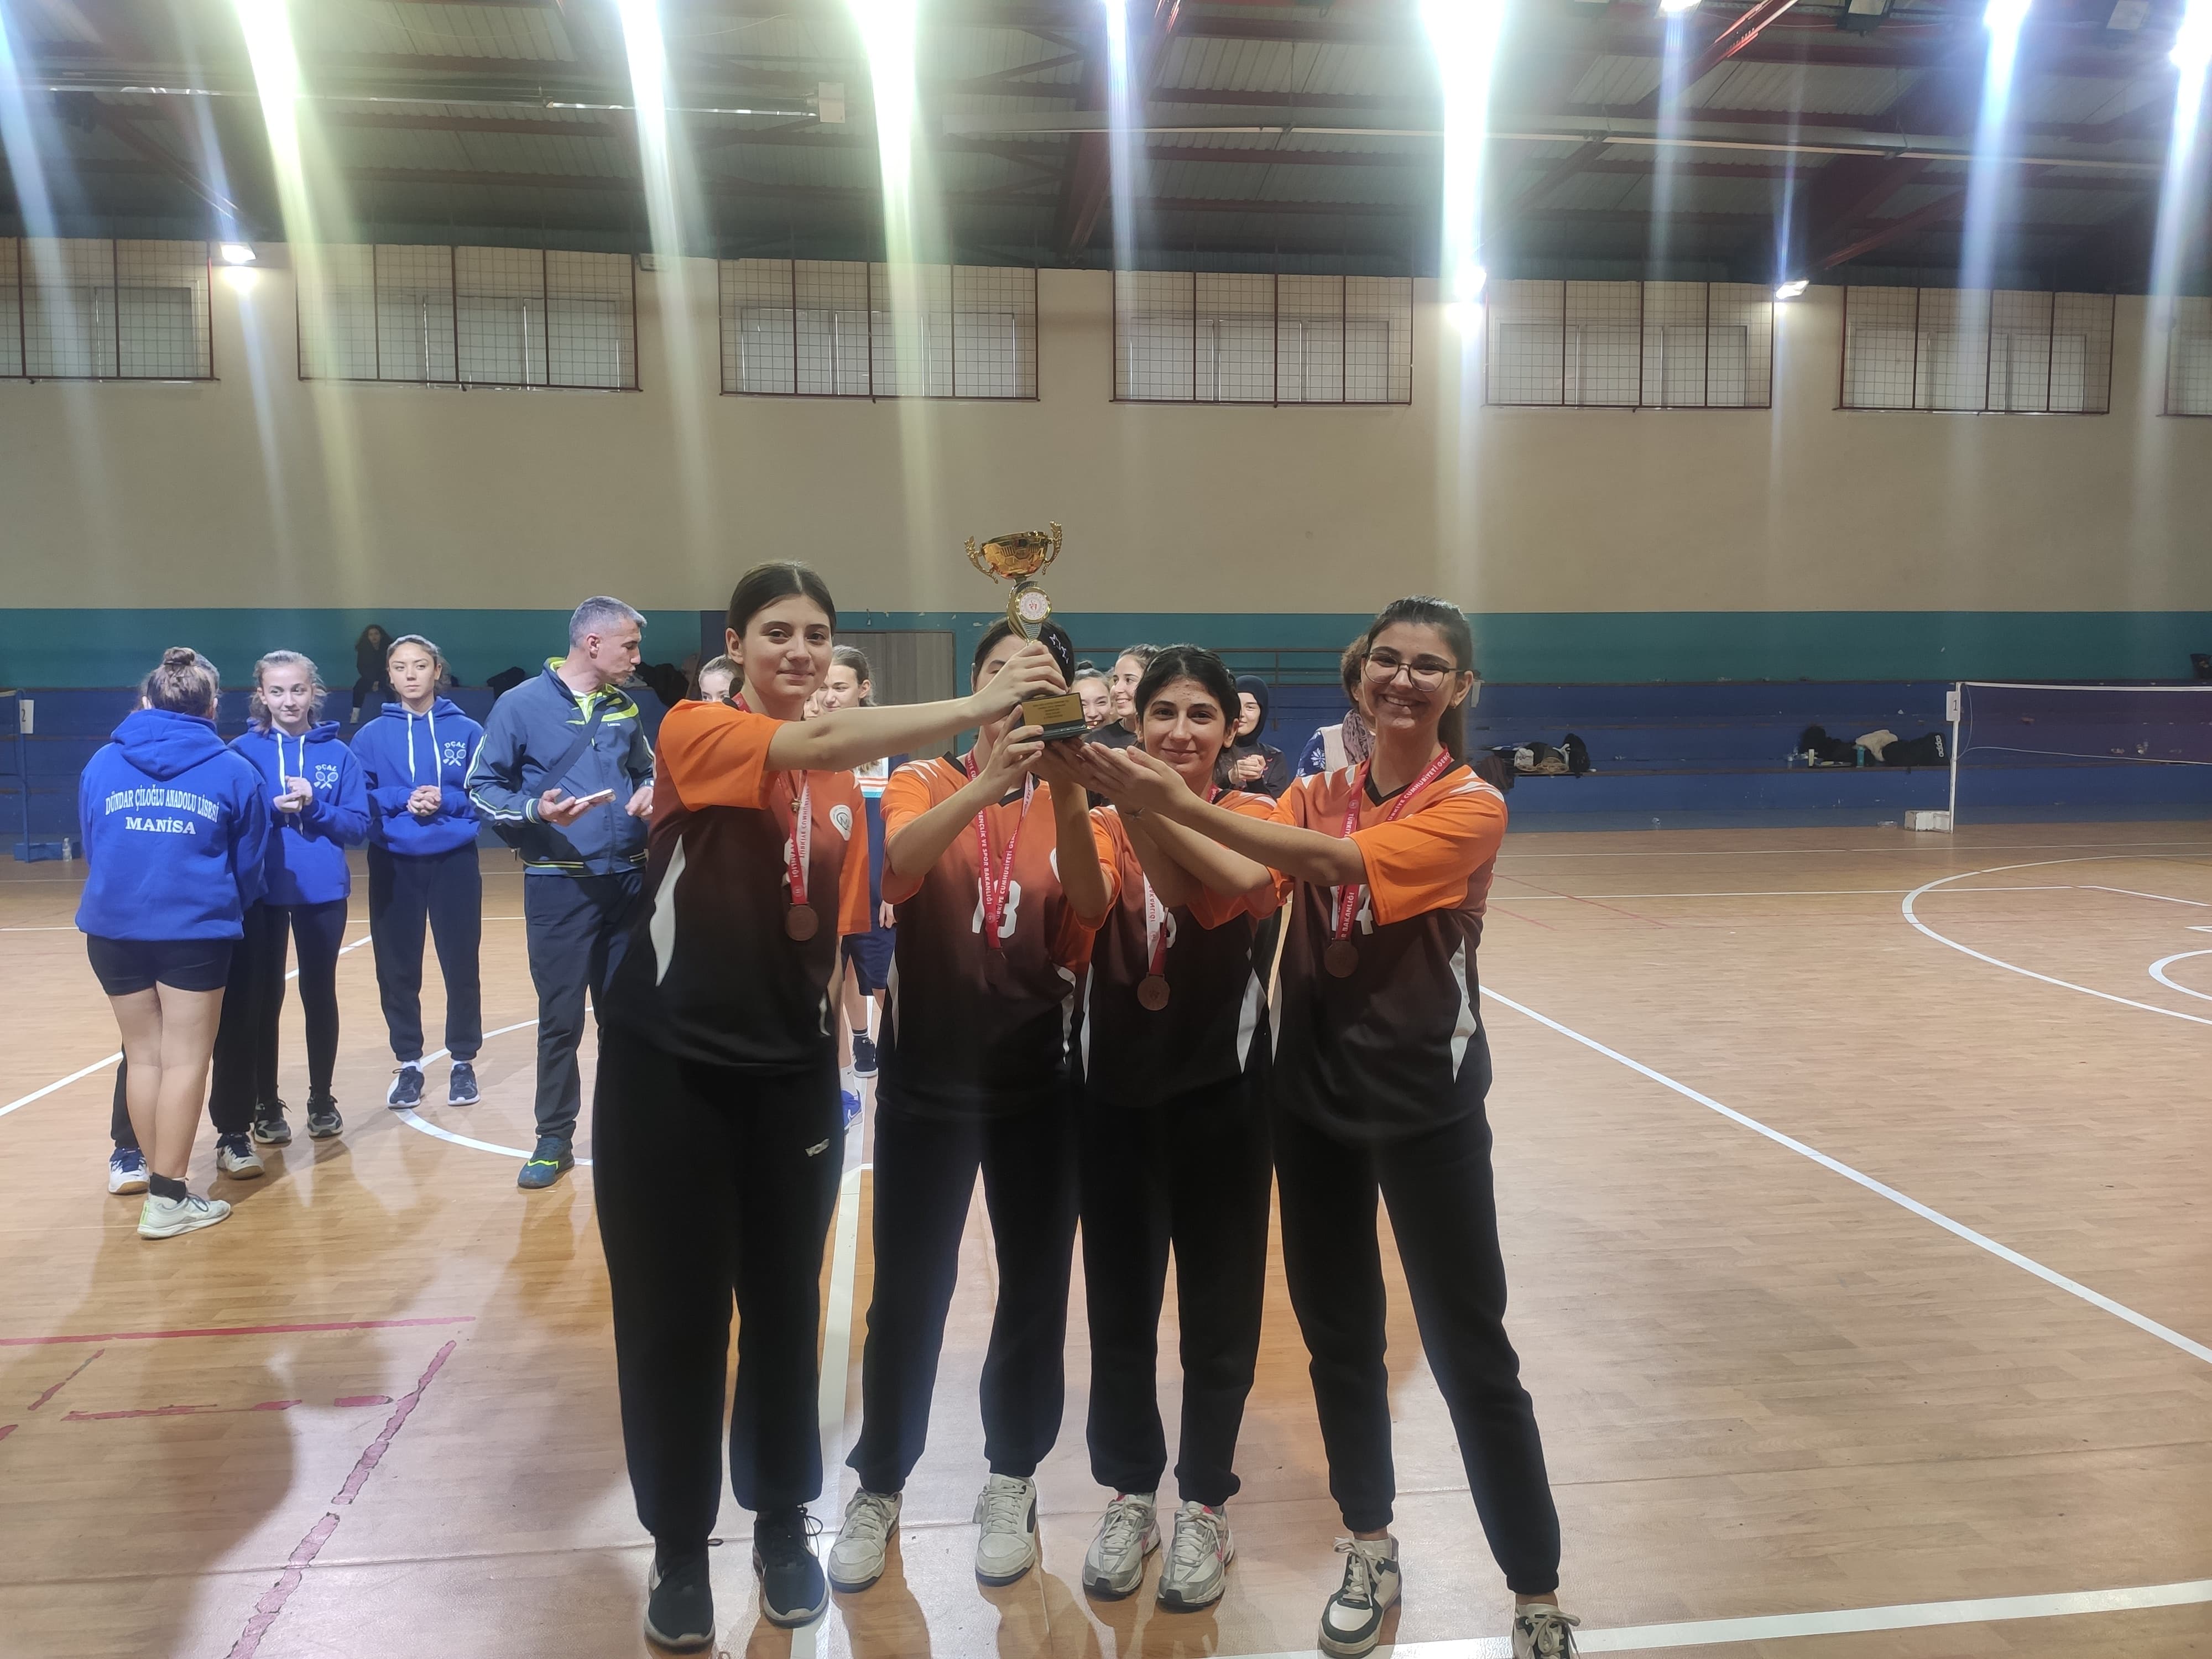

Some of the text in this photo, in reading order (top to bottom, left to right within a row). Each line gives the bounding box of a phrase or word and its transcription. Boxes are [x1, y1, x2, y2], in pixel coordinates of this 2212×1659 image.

[22, 708, 26, 722] 2
[1953, 699, 1958, 711] 1
[1404, 764, 1439, 799] CUMHURİYETİ
[105, 784, 220, 823] DÜNDAR ÇİLOĞLU ANADOLU LİSESİ
[125, 816, 196, 834] MANİSA
[984, 868, 993, 905] BAKANLIĞI
[999, 850, 1013, 894] CUMHURİYETİ
[1342, 892, 1355, 932] BAKANLIĞI
